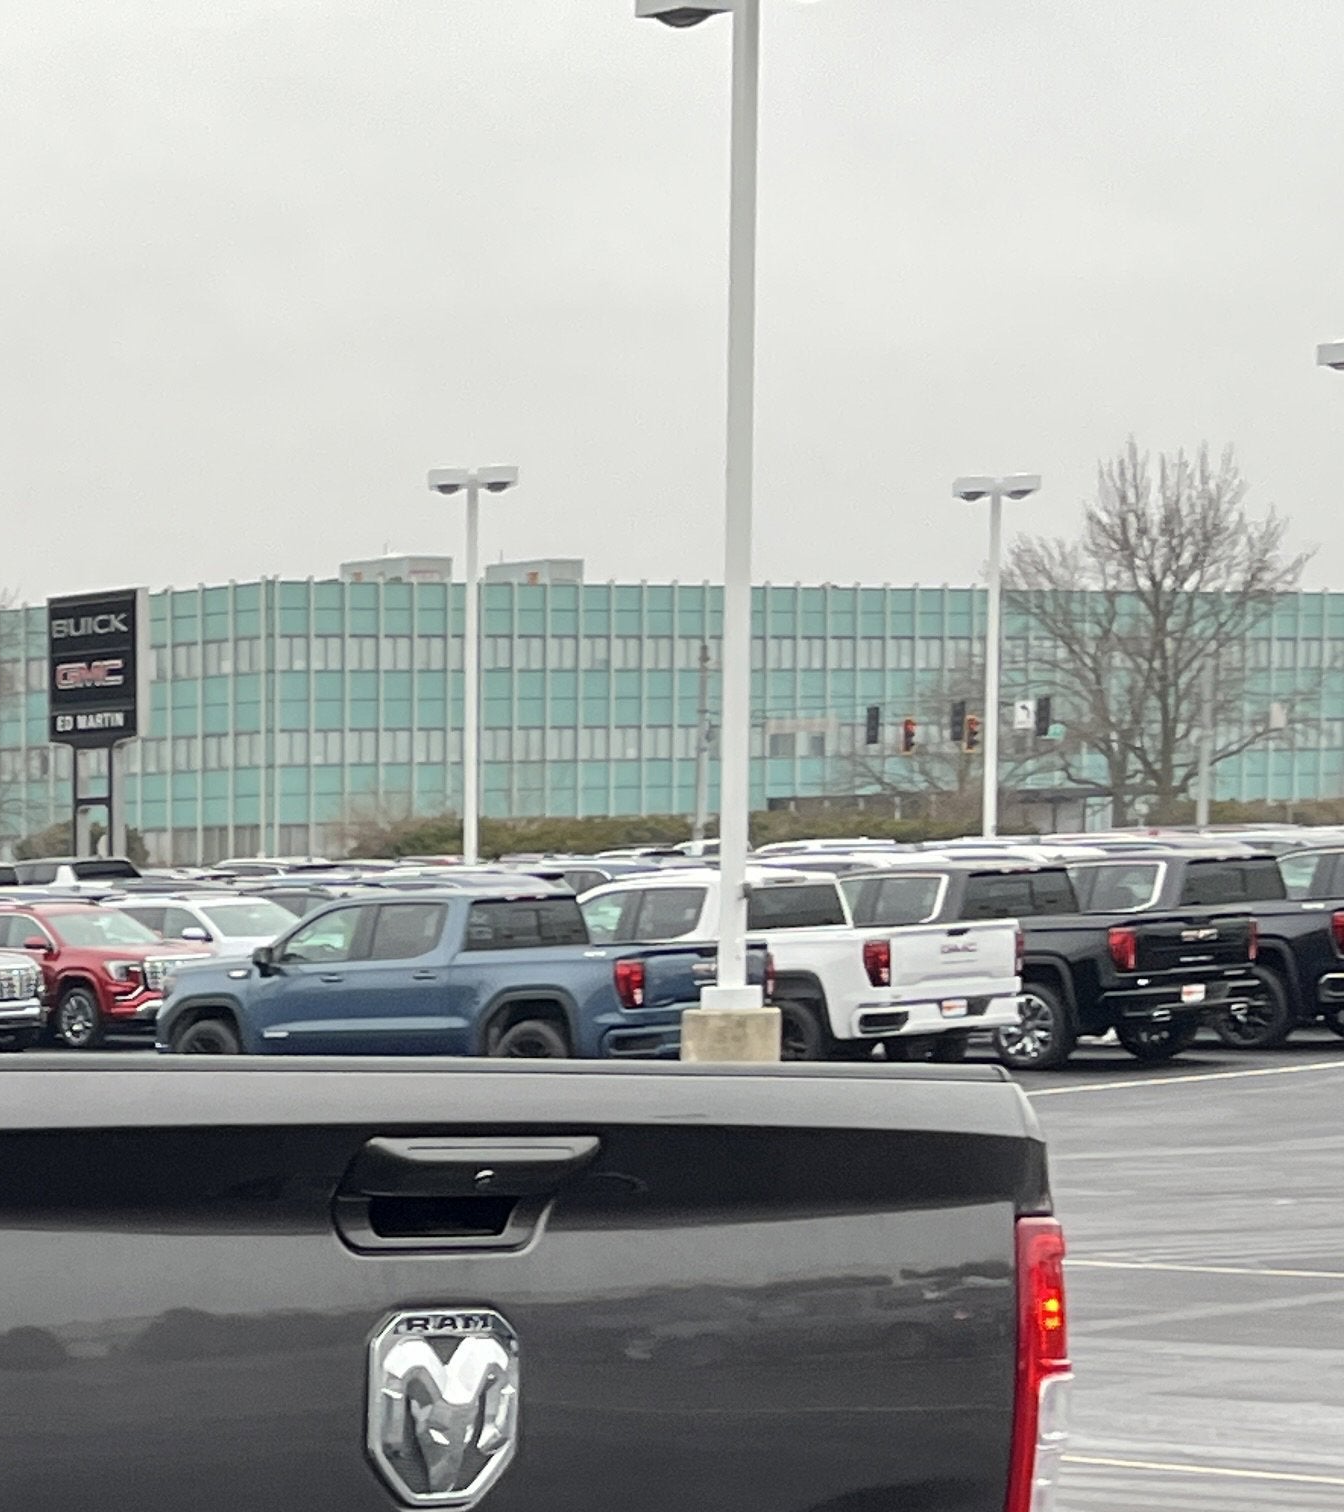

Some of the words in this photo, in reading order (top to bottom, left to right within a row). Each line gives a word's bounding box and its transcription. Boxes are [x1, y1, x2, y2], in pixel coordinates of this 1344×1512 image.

[51, 612, 128, 639] BUICK
[55, 659, 124, 689] GMC
[56, 715, 73, 732] ED
[76, 712, 125, 729] MARTIN
[407, 1316, 489, 1331] RAM
